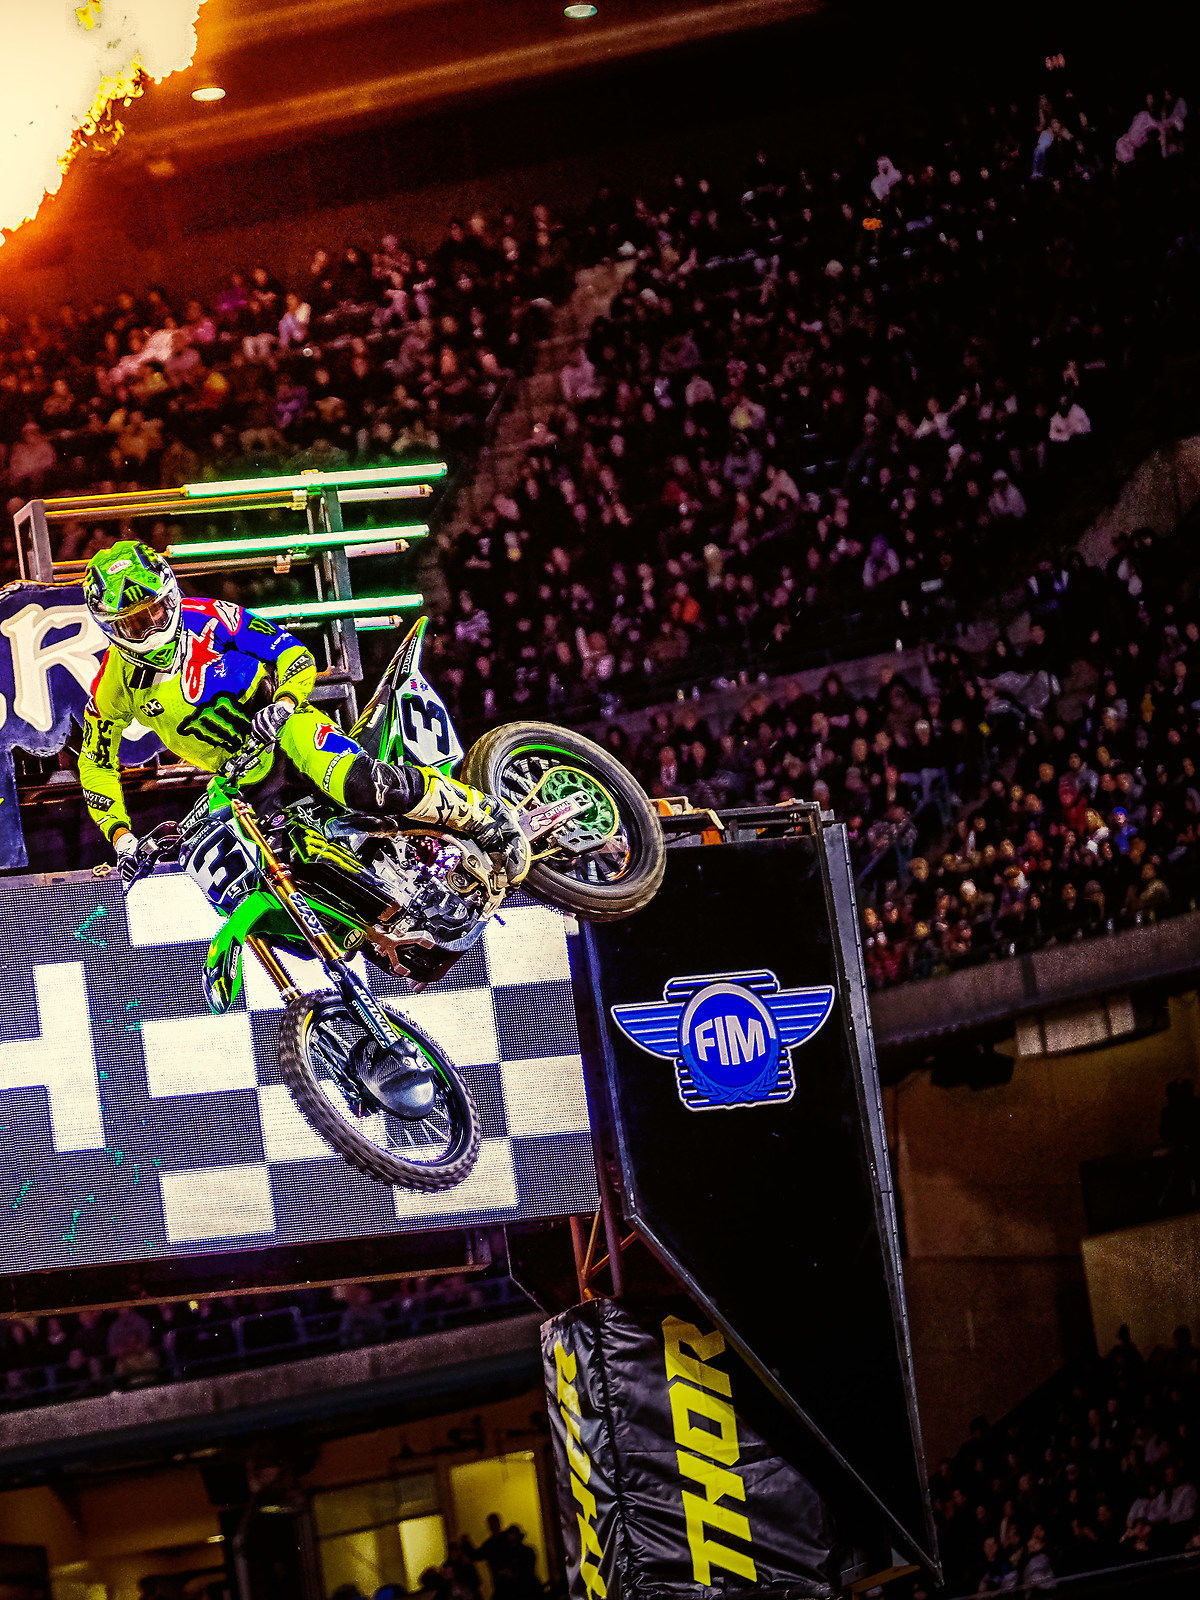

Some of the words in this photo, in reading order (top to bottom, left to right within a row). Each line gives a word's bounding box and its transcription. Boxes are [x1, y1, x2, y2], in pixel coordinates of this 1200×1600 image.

[401, 693, 450, 757] 3
[193, 837, 248, 903] 3
[353, 985, 400, 1047] DUNLOP
[694, 1015, 766, 1066] FIM
[662, 1314, 758, 1587] THOR
